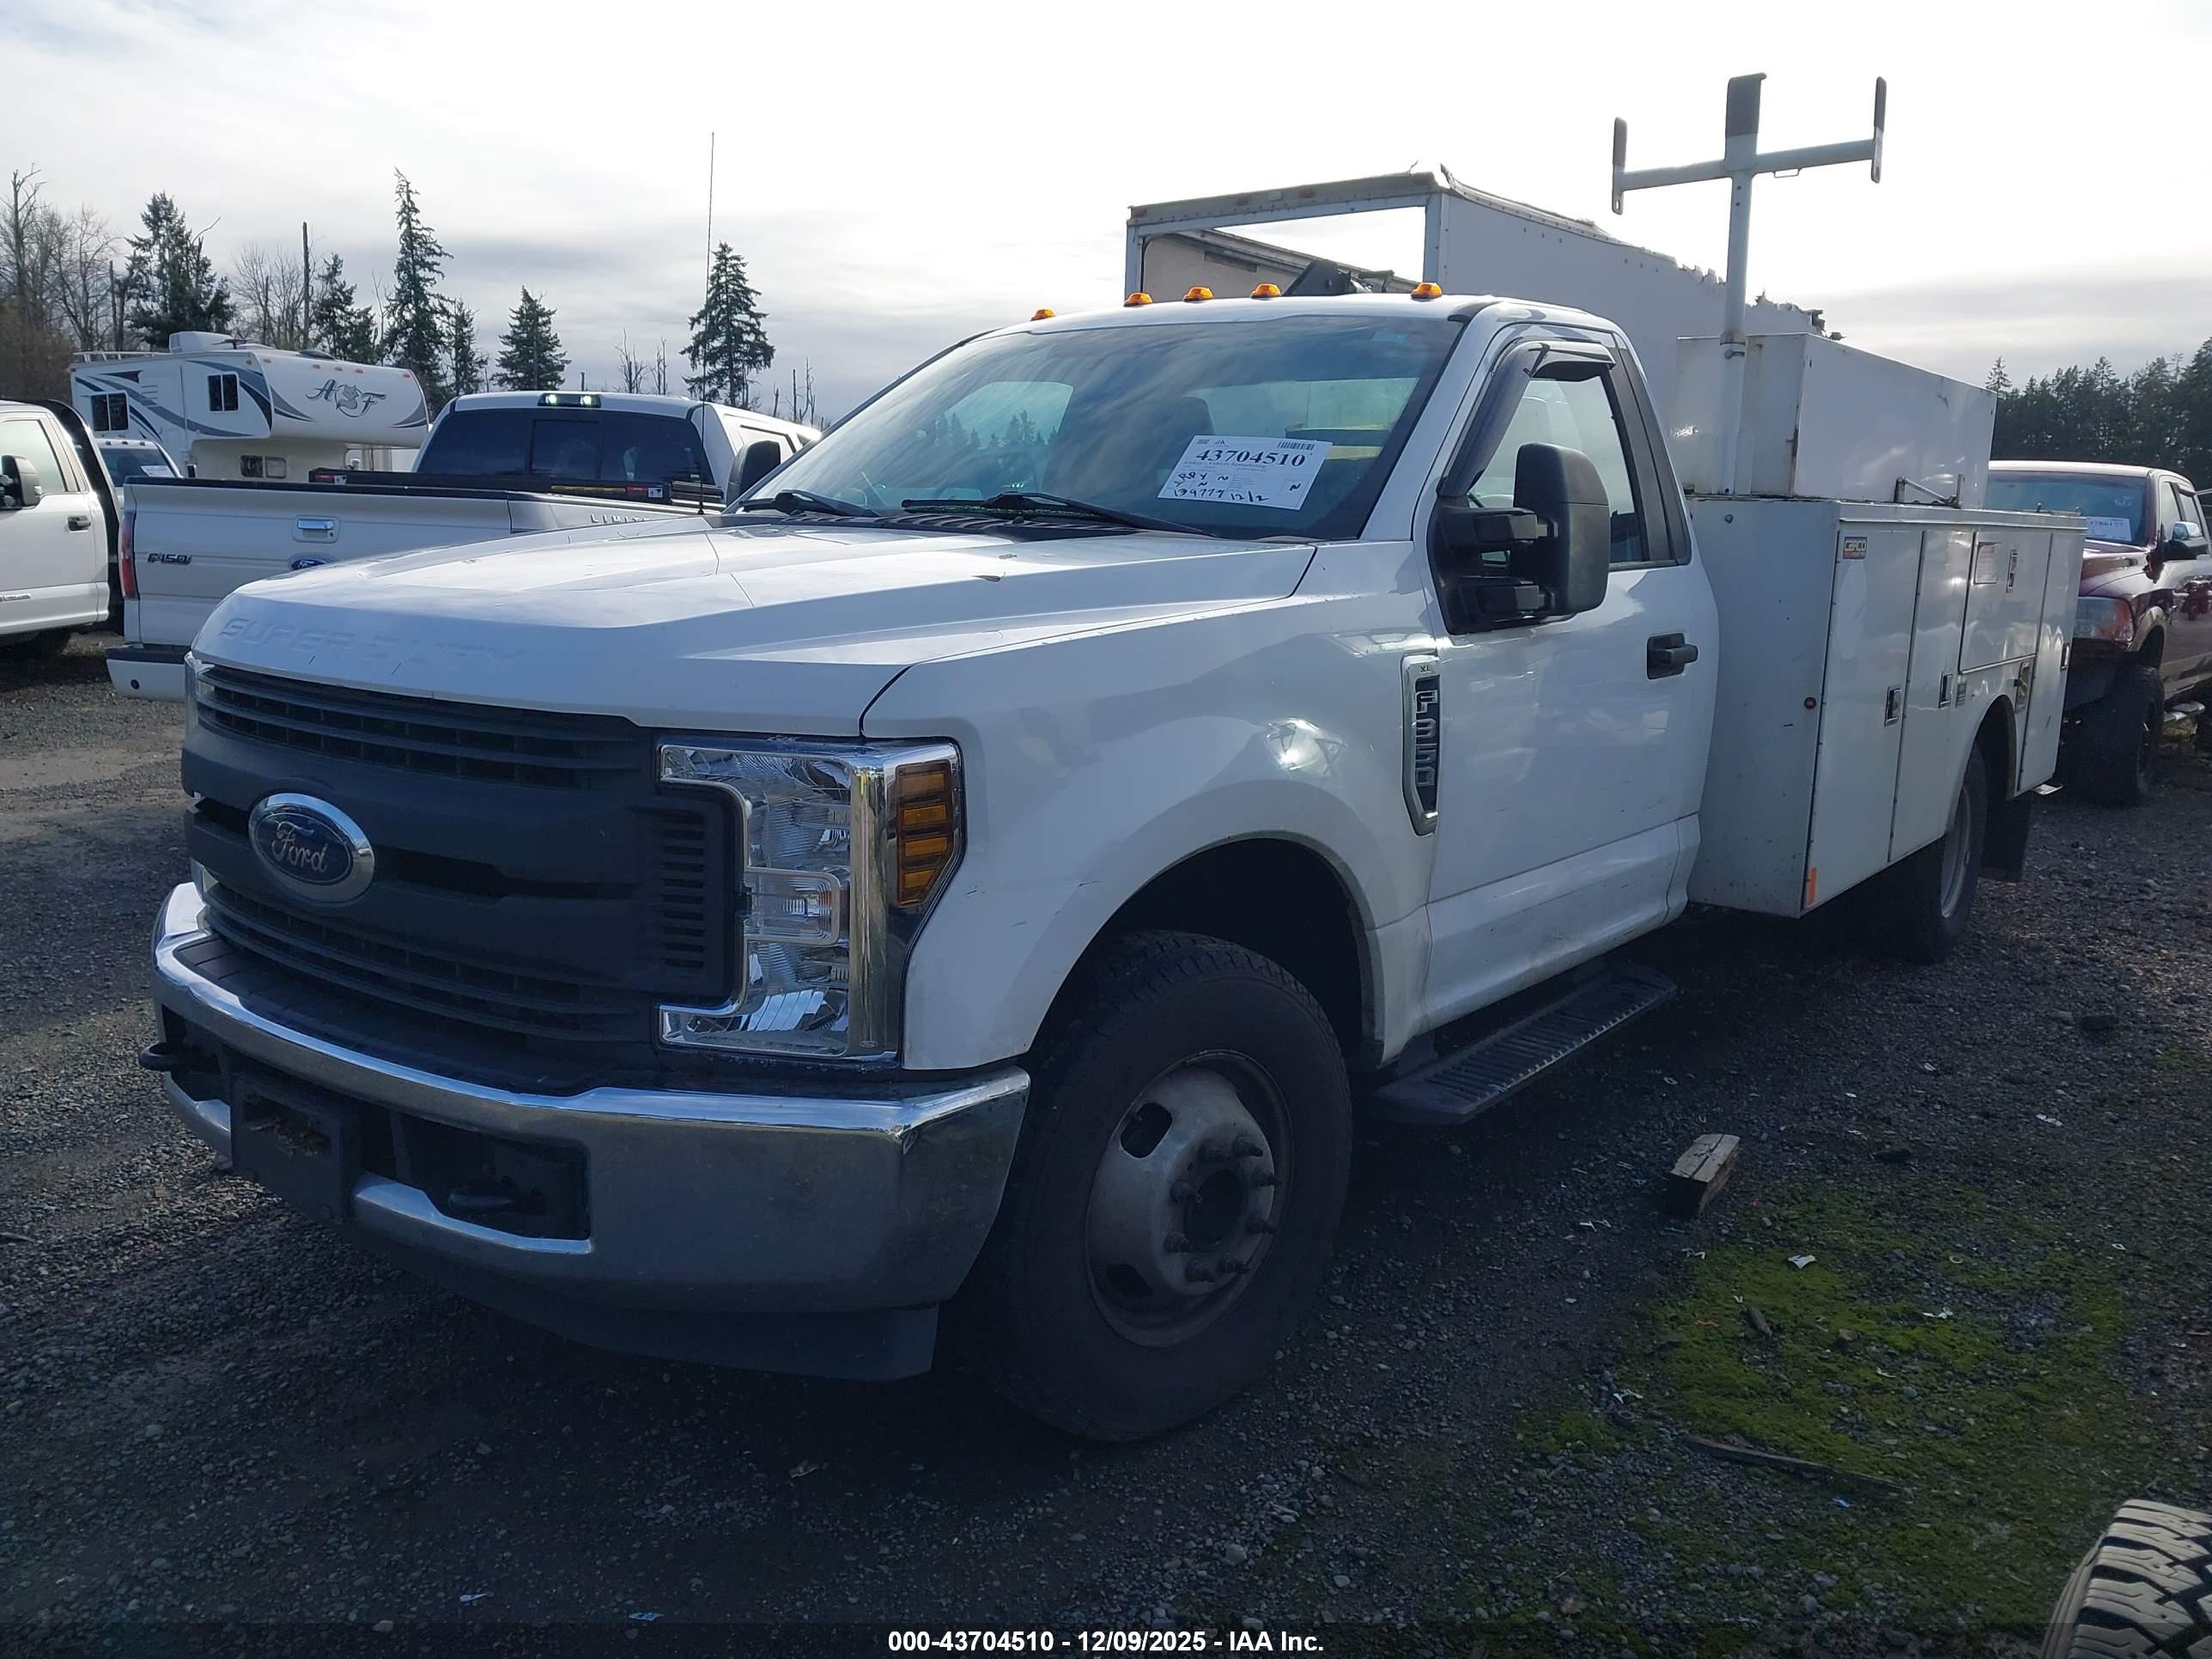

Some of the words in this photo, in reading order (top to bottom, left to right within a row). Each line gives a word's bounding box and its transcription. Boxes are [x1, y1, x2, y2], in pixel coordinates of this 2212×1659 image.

[1196, 449, 1306, 467] 43704510
[217, 617, 356, 660] SUPER
[270, 818, 329, 874] Ford
